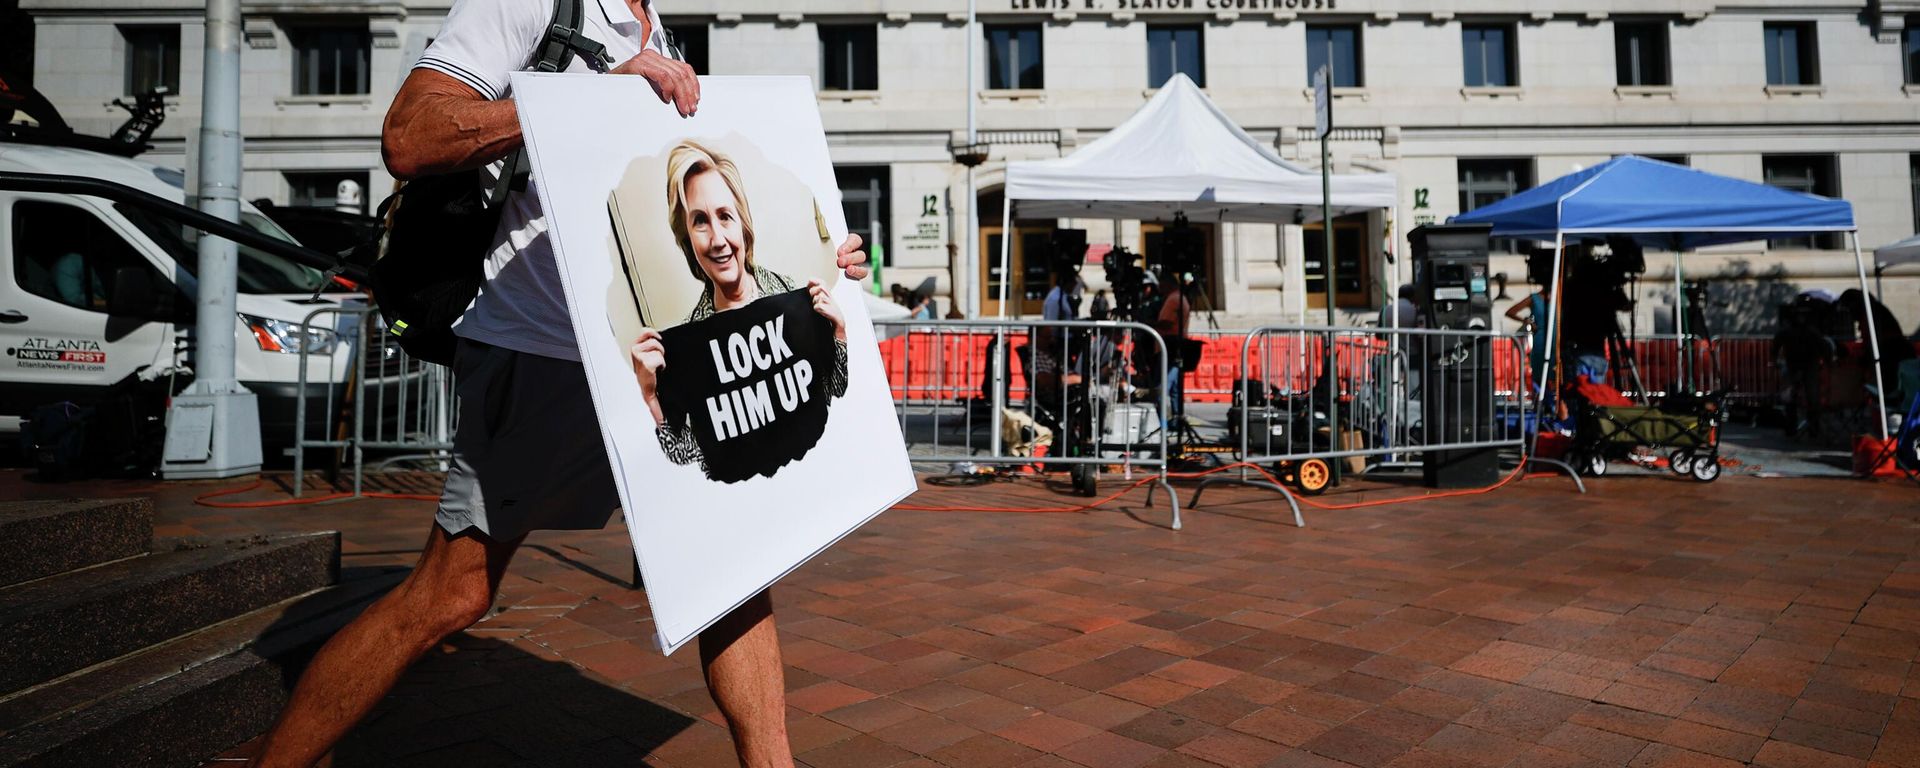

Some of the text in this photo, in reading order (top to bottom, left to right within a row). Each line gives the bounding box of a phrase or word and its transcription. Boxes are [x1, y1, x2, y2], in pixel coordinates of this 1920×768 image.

[921, 195, 938, 217] J2
[23, 338, 100, 350] ATLANTA
[709, 313, 793, 384] LOCK
[20, 350, 103, 361] NEWS FIRST
[17, 361, 104, 371] AtlantaNewsFirst.com
[706, 359, 813, 442] HIM UP
